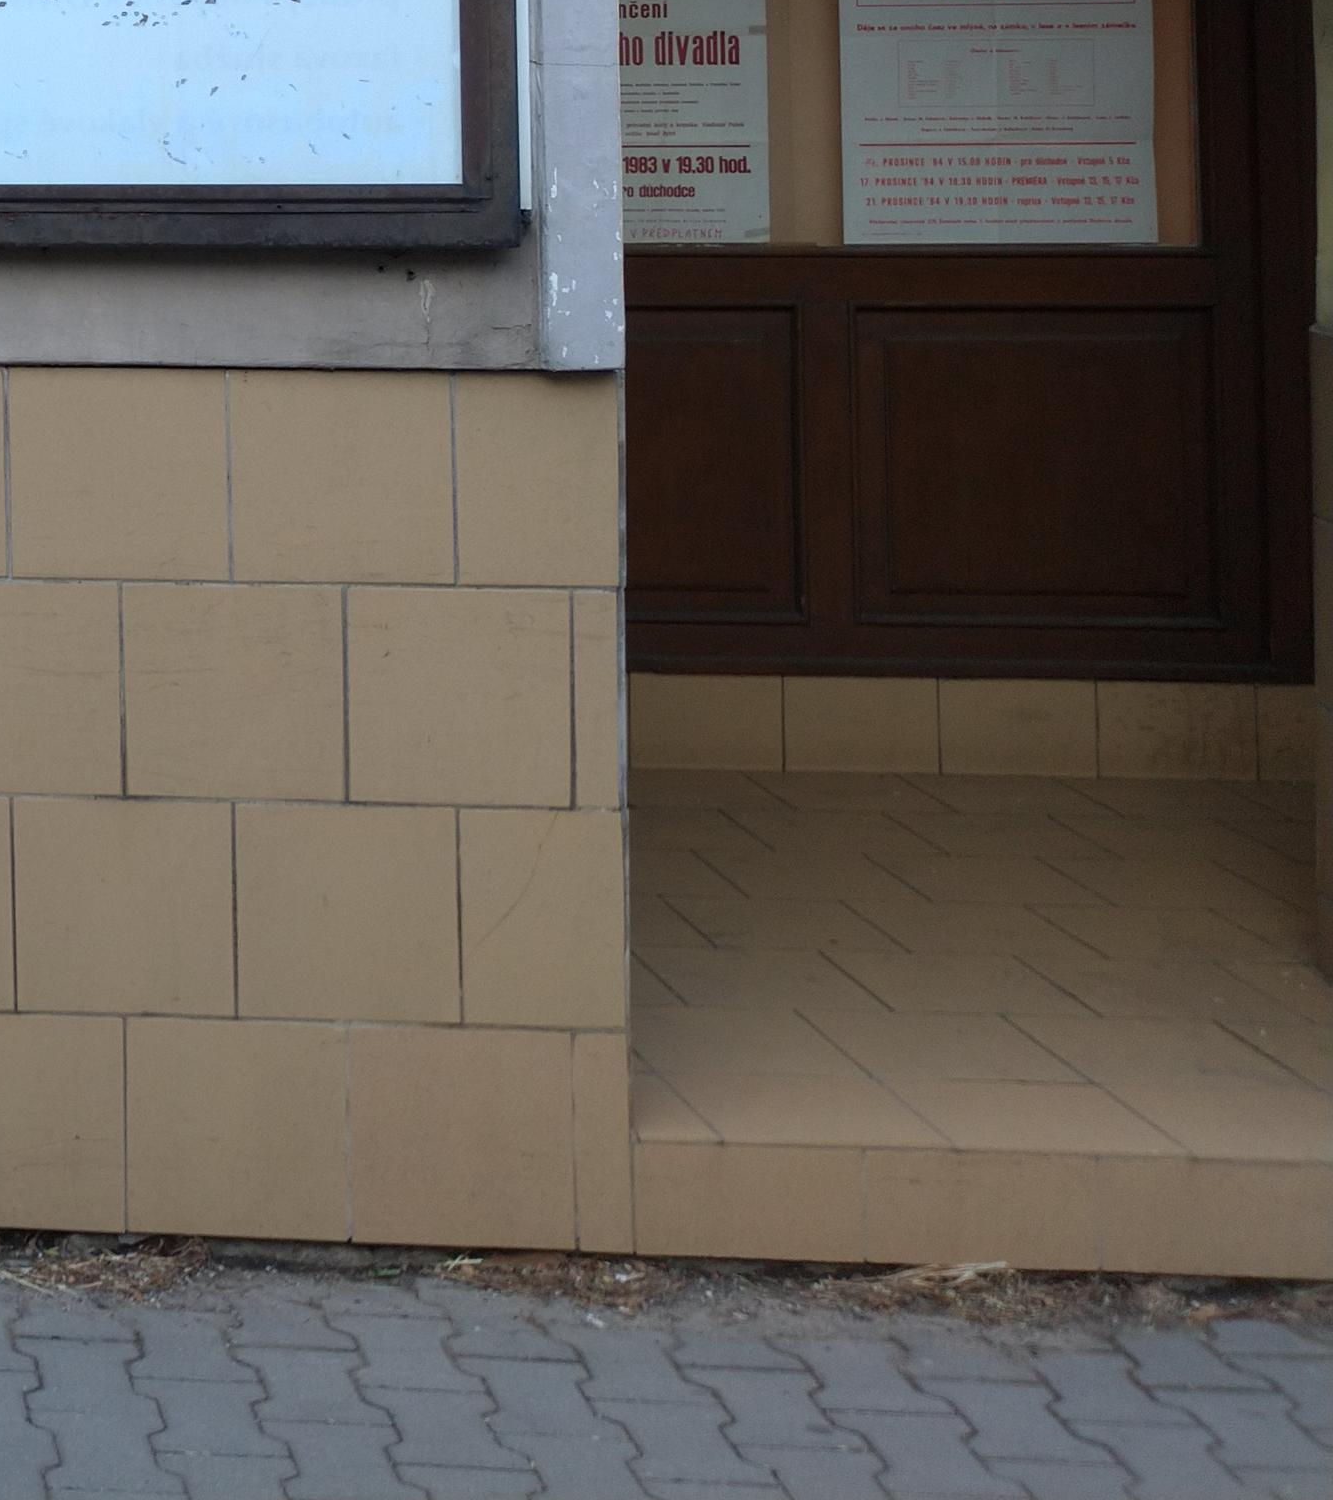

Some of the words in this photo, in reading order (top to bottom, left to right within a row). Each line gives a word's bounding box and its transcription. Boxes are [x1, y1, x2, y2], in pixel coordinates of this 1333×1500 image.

[654, 30, 741, 66] divadla
[622, 156, 658, 174] 1983
[662, 158, 671, 174] v
[676, 156, 715, 174] 19.30
[719, 155, 751, 174] hod.
[638, 184, 696, 198] důchodce
